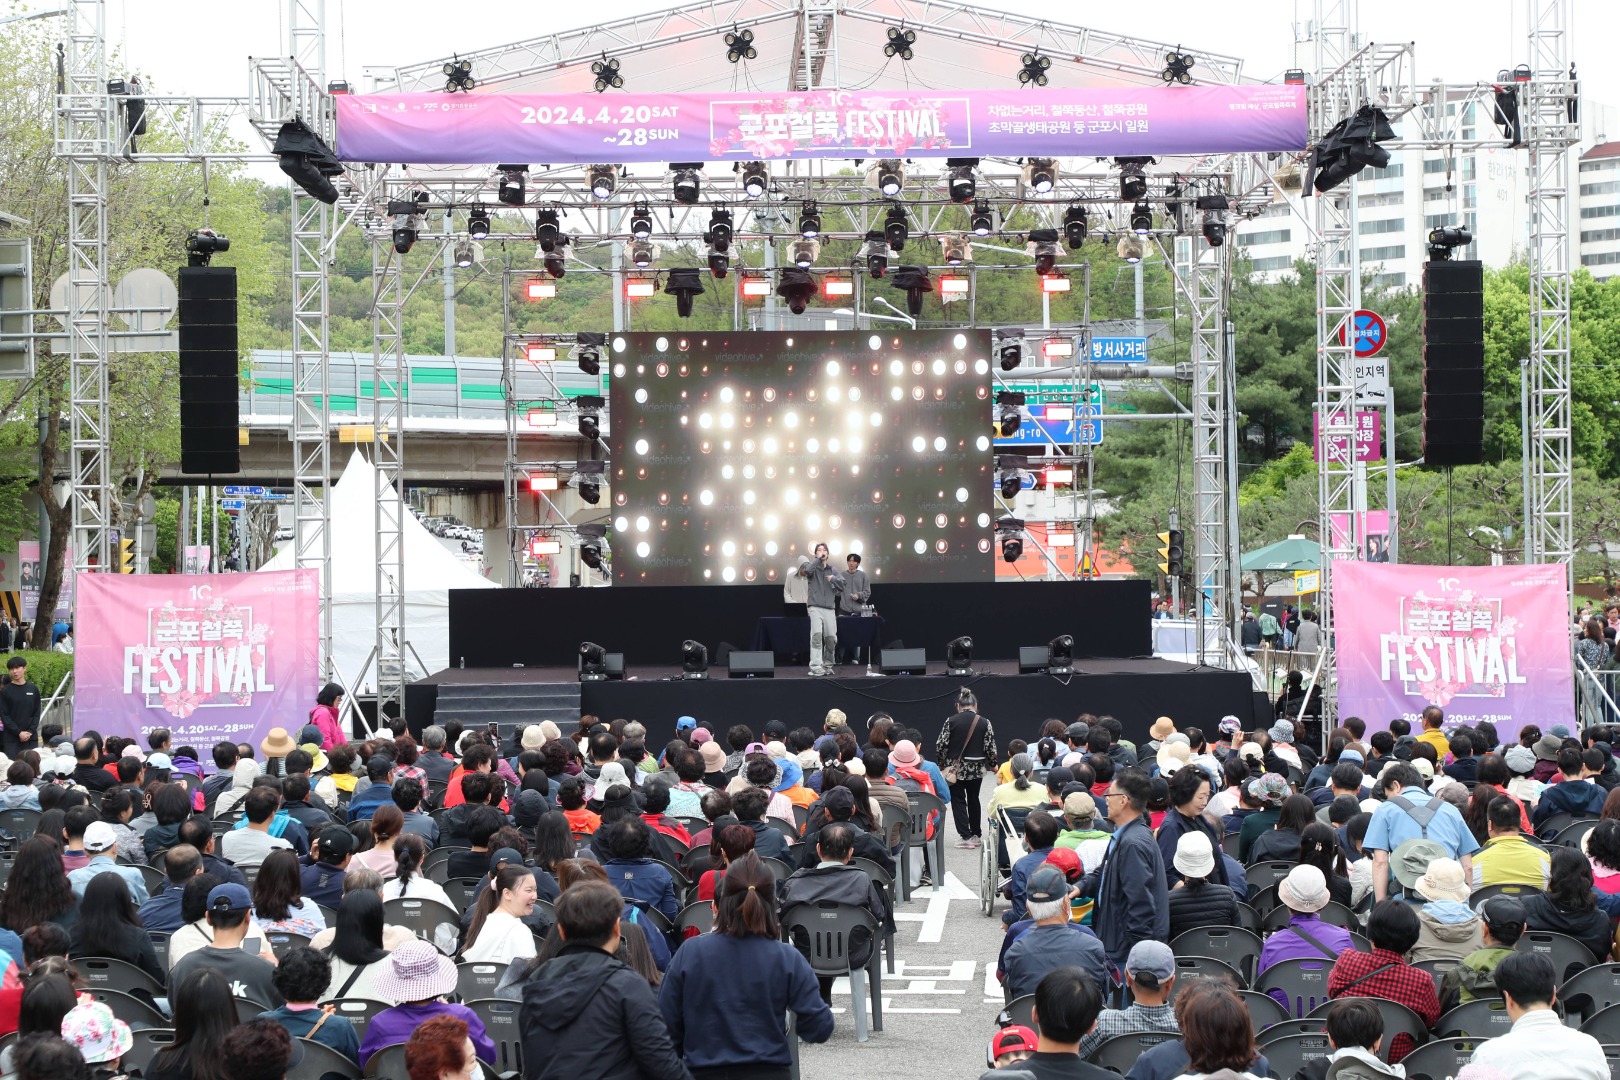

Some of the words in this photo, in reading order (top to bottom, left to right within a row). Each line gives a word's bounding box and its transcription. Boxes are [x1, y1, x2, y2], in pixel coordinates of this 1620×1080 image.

[987, 104, 1049, 119] 차없는거리,
[1050, 104, 1100, 118] 철쭉동산,
[1102, 103, 1148, 117] 철쭉공원
[739, 112, 839, 141] 군포철쭉
[845, 109, 946, 138] FESTIVAL
[988, 121, 1071, 134] 초막골생태공원
[1073, 120, 1084, 134] 등
[1087, 120, 1123, 133] 군포시
[1125, 120, 1149, 133] 일원
[641, 353, 682, 363] videohive
[715, 352, 756, 362] videohive
[777, 352, 817, 362] videohive
[1350, 365, 1385, 379] 인지역
[641, 403, 682, 412] videohive
[642, 455, 683, 465] videohive
[643, 557, 684, 567] videohive
[1408, 610, 1492, 632] 군포철쭉
[157, 620, 243, 642] 군포철쭉
[1380, 634, 1527, 684] FESTIVAL
[123, 645, 275, 694] FESTIVAL
